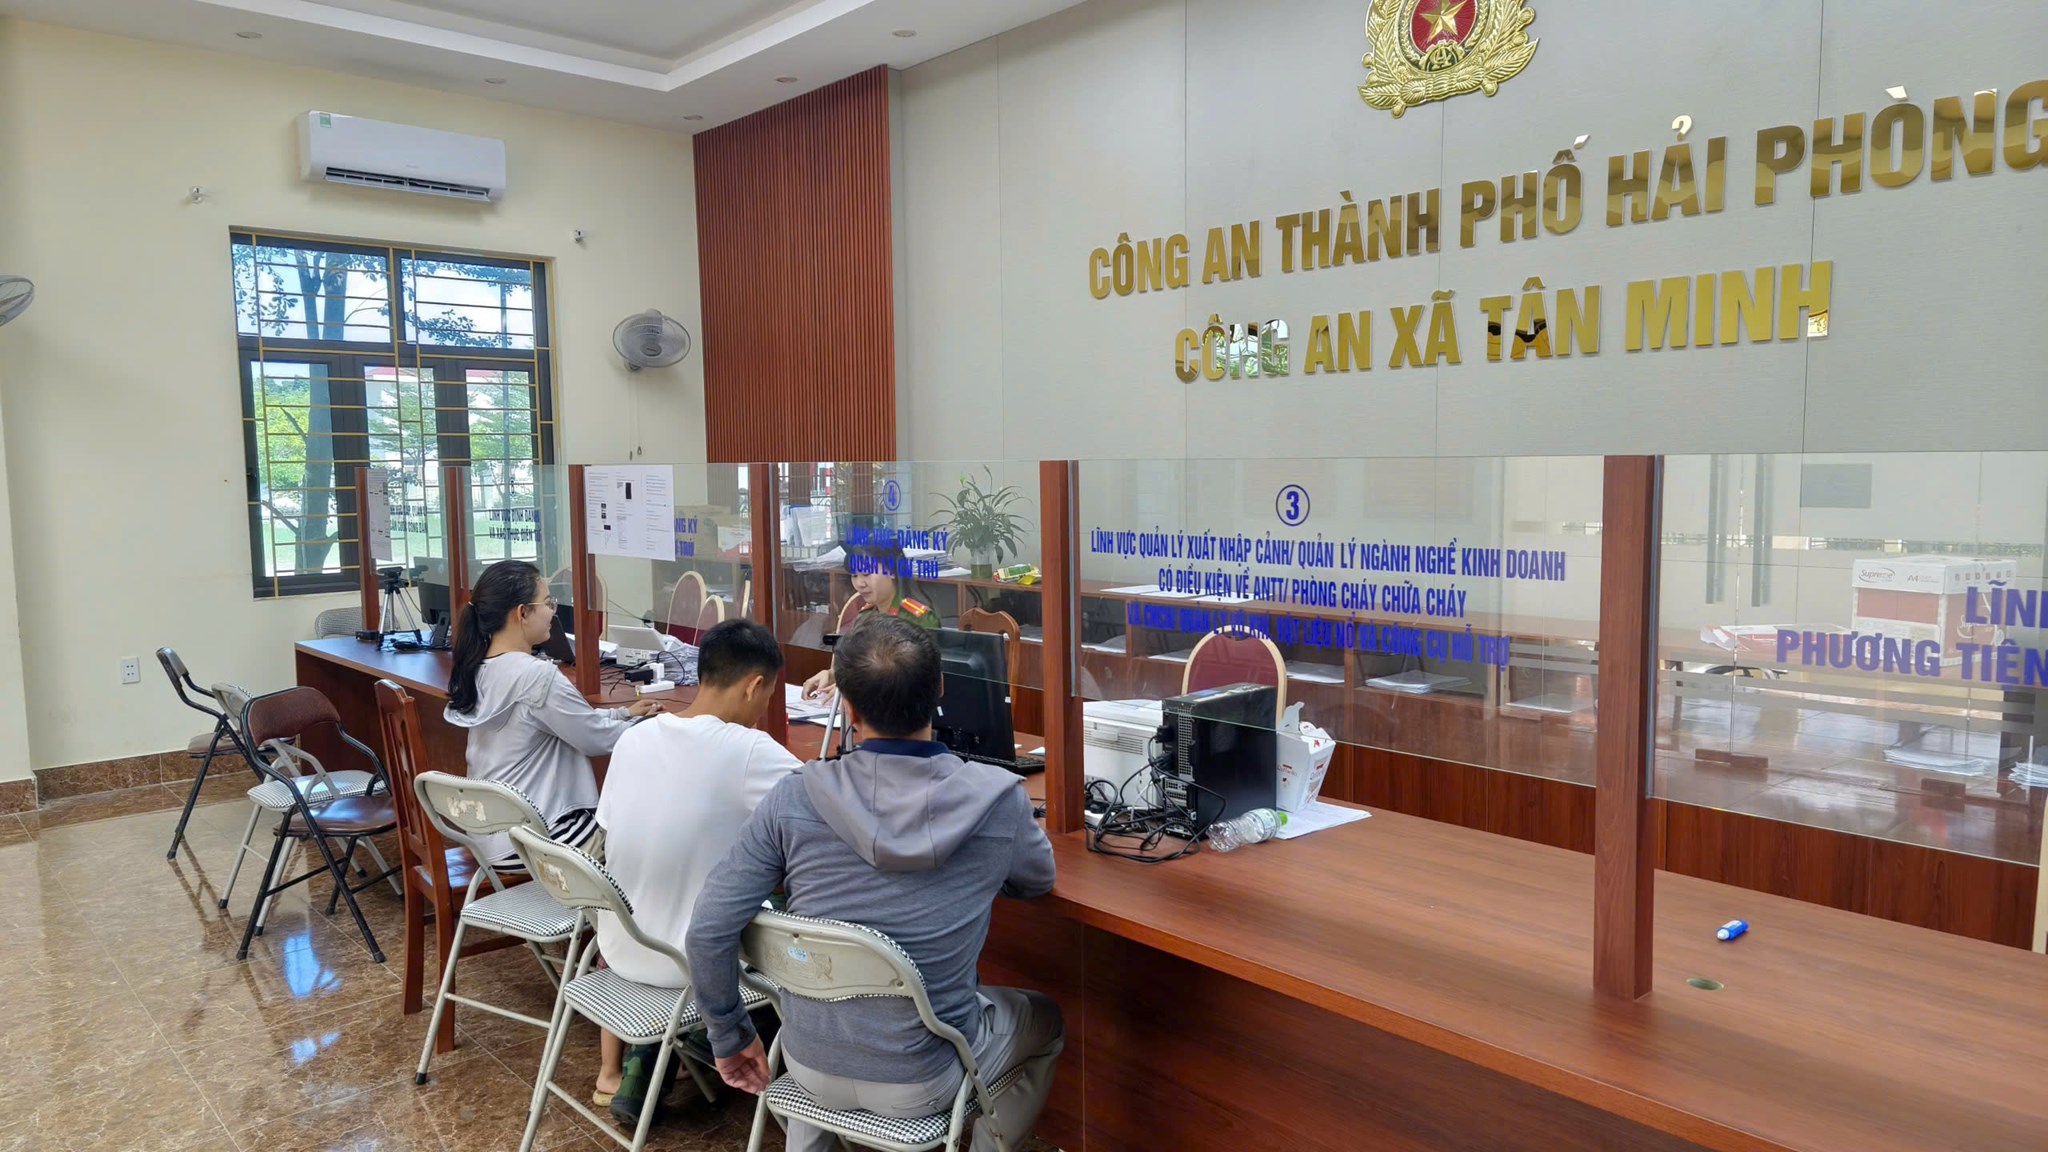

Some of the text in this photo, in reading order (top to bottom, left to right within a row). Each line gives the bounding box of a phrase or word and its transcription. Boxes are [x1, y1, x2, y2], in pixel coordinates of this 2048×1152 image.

[1089, 79, 2048, 299] CÔNG AN THÀNH PHỐ HẢI PHÒNG
[1175, 260, 1832, 384] CÔNG AN XÃ TÂN MINH
[888, 485, 897, 507] 4
[1285, 490, 1301, 521] 3
[897, 526, 929, 550] ĐĂNG
[933, 527, 948, 551] KÝ
[1091, 526, 1566, 581] LĨNH VỰC QUẢN LÝ XUẤT NHẬP CẢNH/ QUẢN LÝ NGÀNH NGHỀ KINH DOANH
[916, 557, 939, 579] TRÚ
[1158, 563, 1467, 618] CÓ ĐIỀU KIỆN VỀ ANTT/ PHÒNG CHÁY CHỮA CHÁY
[1277, 612, 1299, 646] VẬT
[1303, 615, 1333, 651] LIỆU
[1336, 611, 1356, 650] NỔ
[1359, 620, 1377, 652] VÀ
[1382, 622, 1422, 657] CÔNG
[1426, 630, 1447, 664] CỤ
[1452, 623, 1474, 663] HỖ
[1478, 635, 1511, 672] TRỢ
[1776, 629, 2048, 690] PHƯƠNG TIỆN
